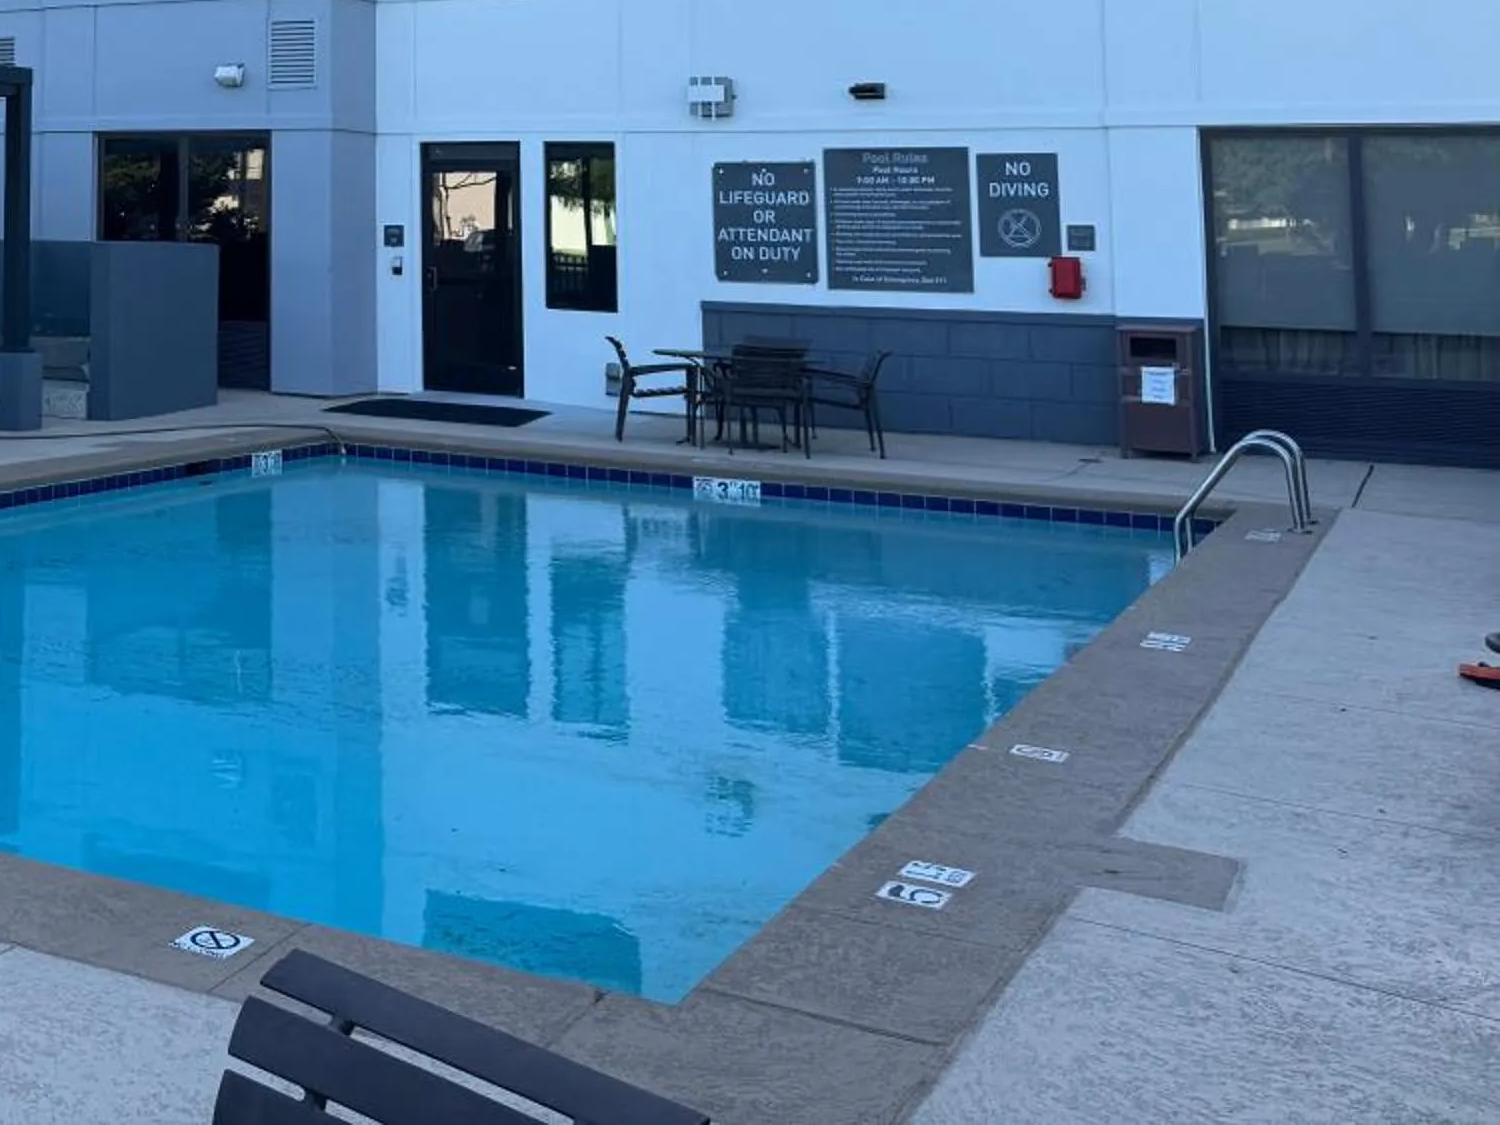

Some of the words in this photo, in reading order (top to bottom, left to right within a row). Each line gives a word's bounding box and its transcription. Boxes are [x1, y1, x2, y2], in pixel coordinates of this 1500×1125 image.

[1005, 161, 1031, 176] NO
[751, 172, 776, 186] NO
[989, 182, 1050, 197] DIVING
[719, 190, 810, 206] LIFEGUARD
[752, 210, 776, 224] OR
[718, 227, 813, 243] ATTENDANT
[731, 246, 754, 260] ON
[759, 246, 801, 261] DUTY
